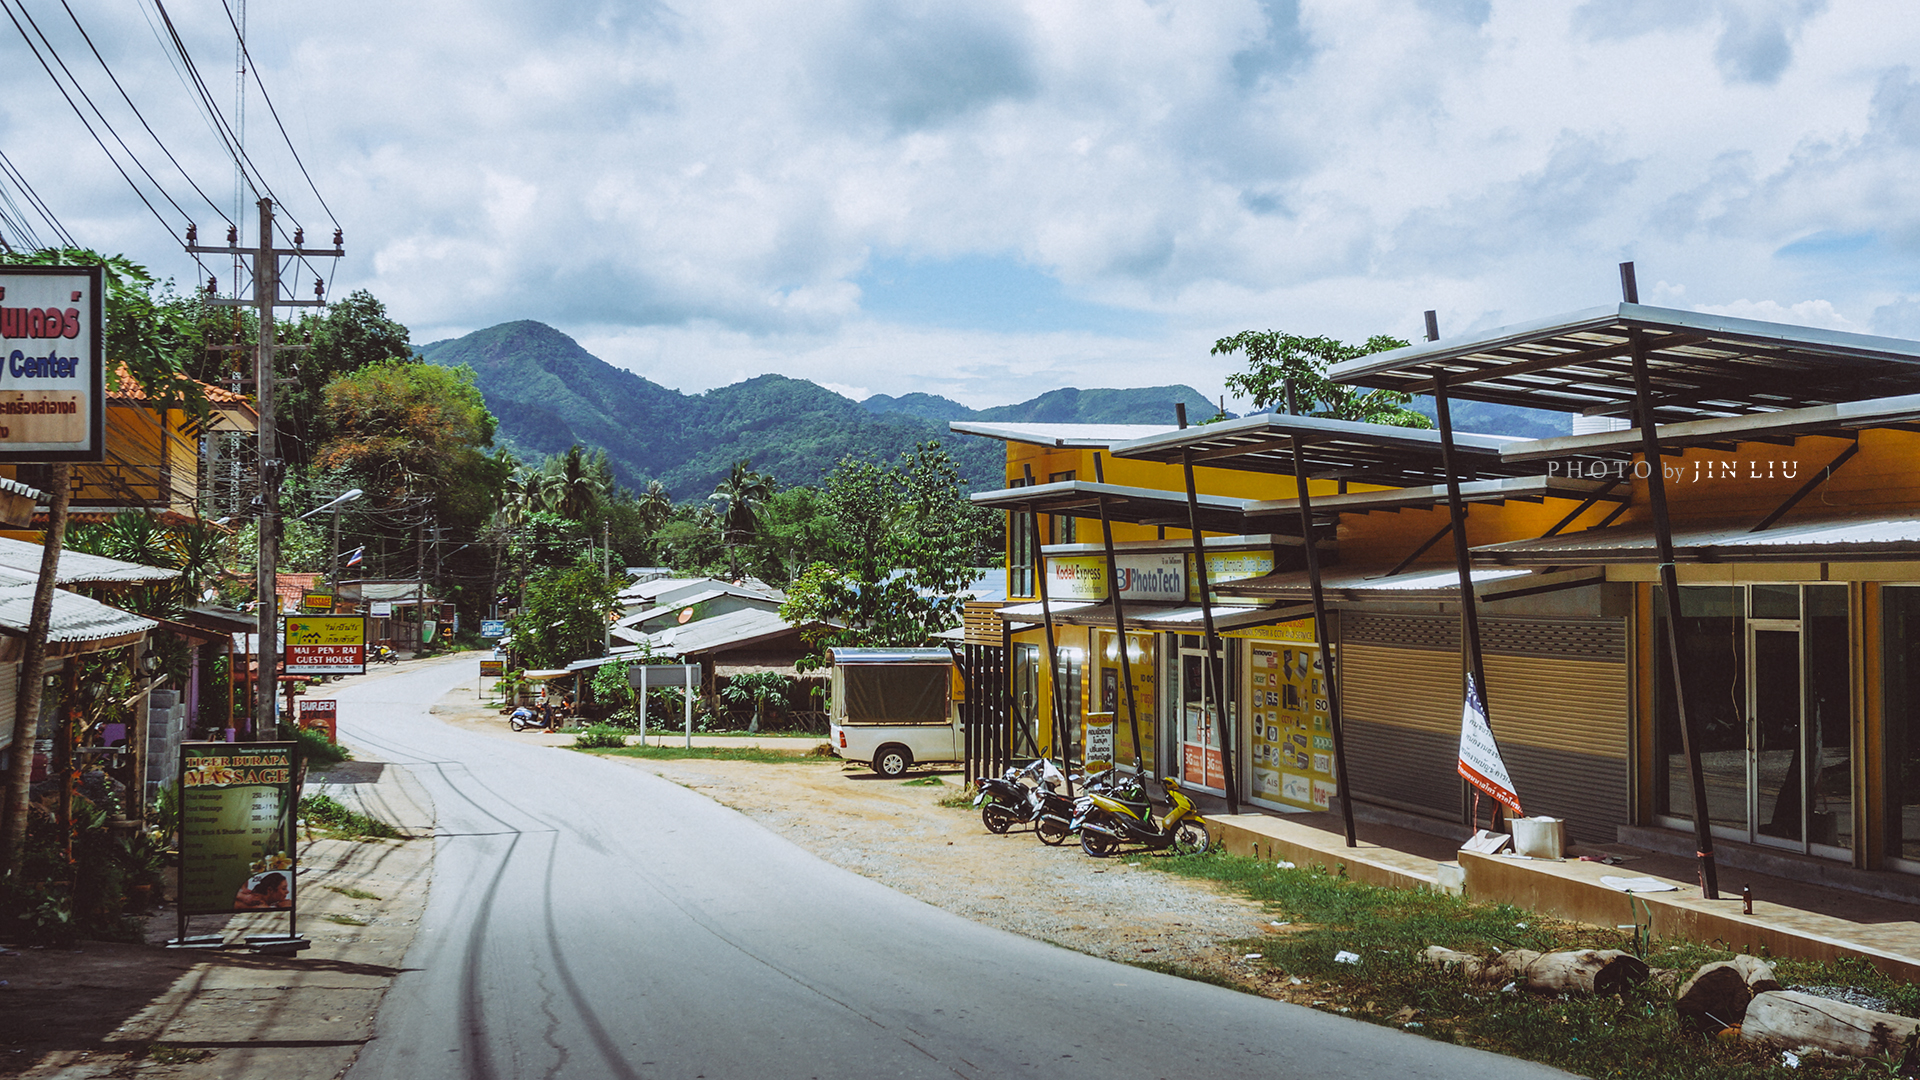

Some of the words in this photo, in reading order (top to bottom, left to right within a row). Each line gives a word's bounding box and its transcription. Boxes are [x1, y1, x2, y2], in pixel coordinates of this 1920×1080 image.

[9, 349, 79, 378] Center
[1056, 564, 1076, 580] Kodak
[1076, 564, 1101, 583] Express
[1131, 567, 1180, 592] PhotoTech
[294, 646, 310, 654] MAI
[318, 646, 335, 654] PEN
[342, 646, 357, 654] RAI
[1253, 648, 1272, 656] lenovo
[296, 656, 323, 664] GUEST
[326, 656, 354, 664] HOUSE
[301, 701, 336, 711] BURGER
[186, 756, 231, 767] TIGER
[232, 755, 289, 766] BURAPA
[1185, 752, 1193, 765] 3G
[1207, 757, 1215, 770] 3G
[187, 768, 290, 784] MASSAGE
